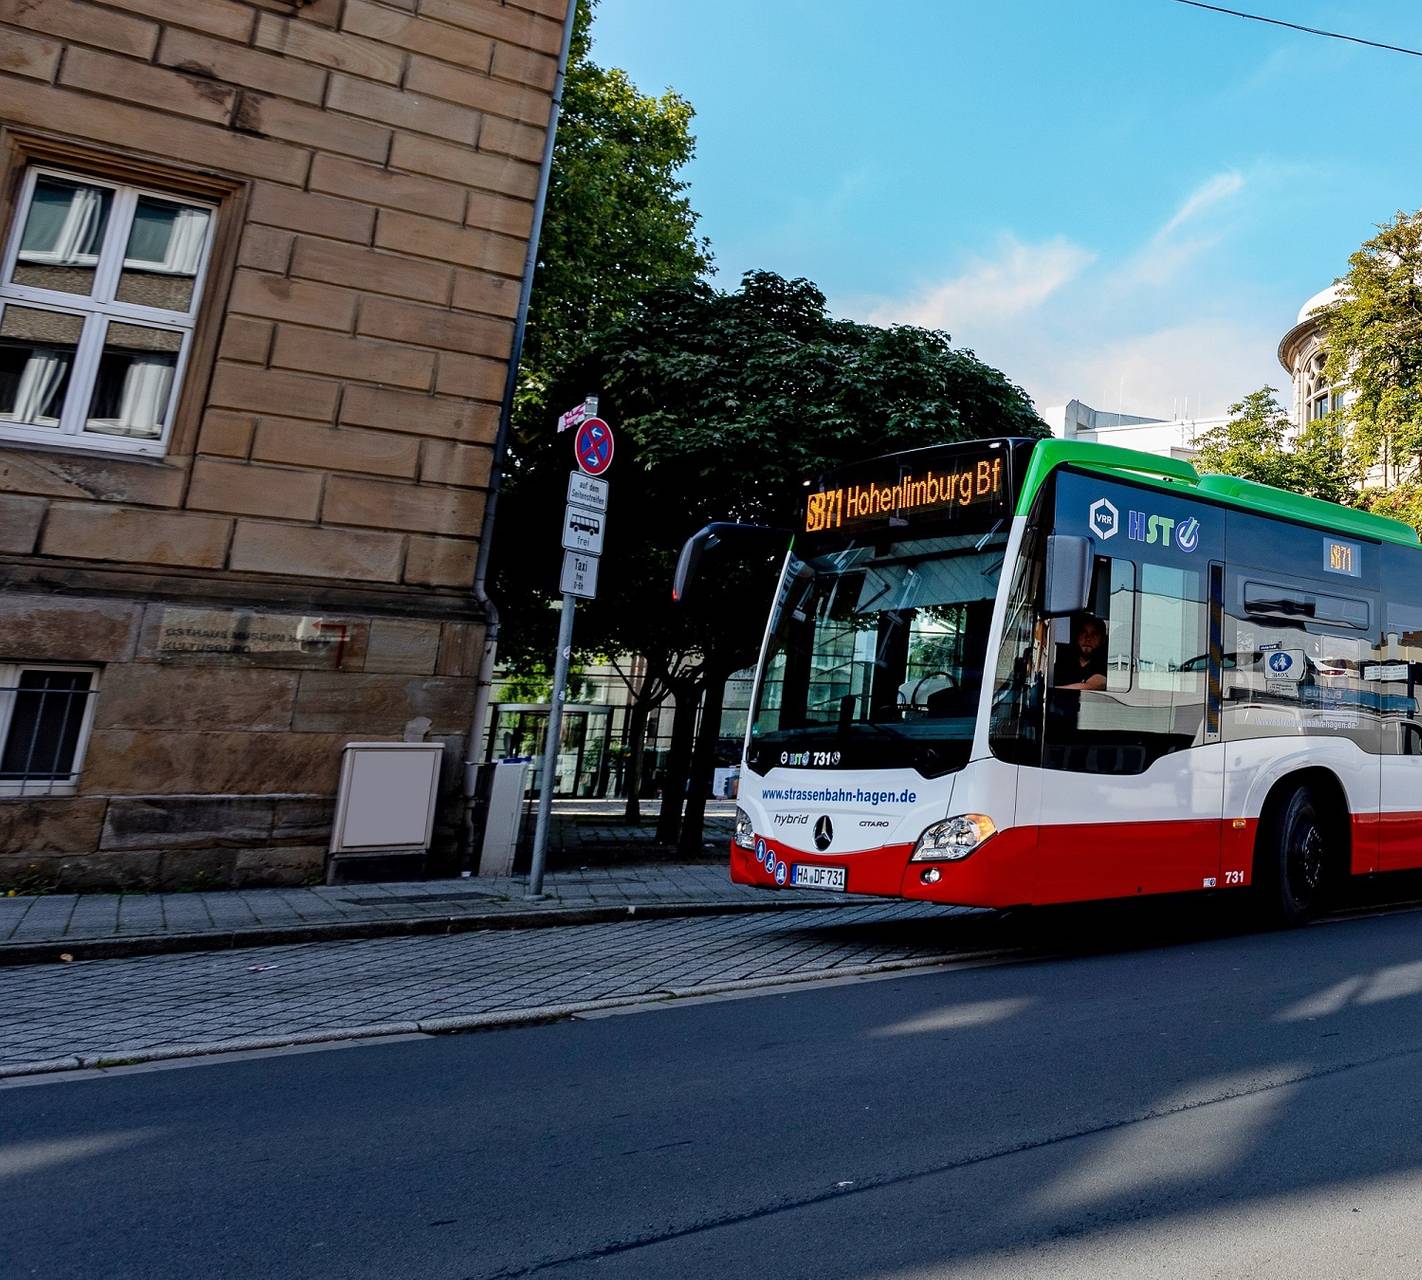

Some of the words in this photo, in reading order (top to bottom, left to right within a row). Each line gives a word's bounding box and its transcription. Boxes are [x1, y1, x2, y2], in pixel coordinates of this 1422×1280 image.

[589, 483, 599, 492] dem
[806, 489, 843, 532] SB71
[847, 472, 973, 517] Hohenlimburg
[977, 457, 1001, 495] Bf
[1096, 513, 1113, 525] VRR
[1128, 510, 1175, 547] HST
[577, 535, 590, 547] frei
[575, 558, 588, 572] Taxi
[813, 751, 831, 766] 731
[762, 787, 917, 805] www.strassenbahn-hagen.de
[774, 814, 810, 826] hybrid
[797, 867, 808, 883] HA
[814, 869, 826, 884] DF
[826, 870, 844, 886] 731
[1225, 870, 1244, 884] 731
